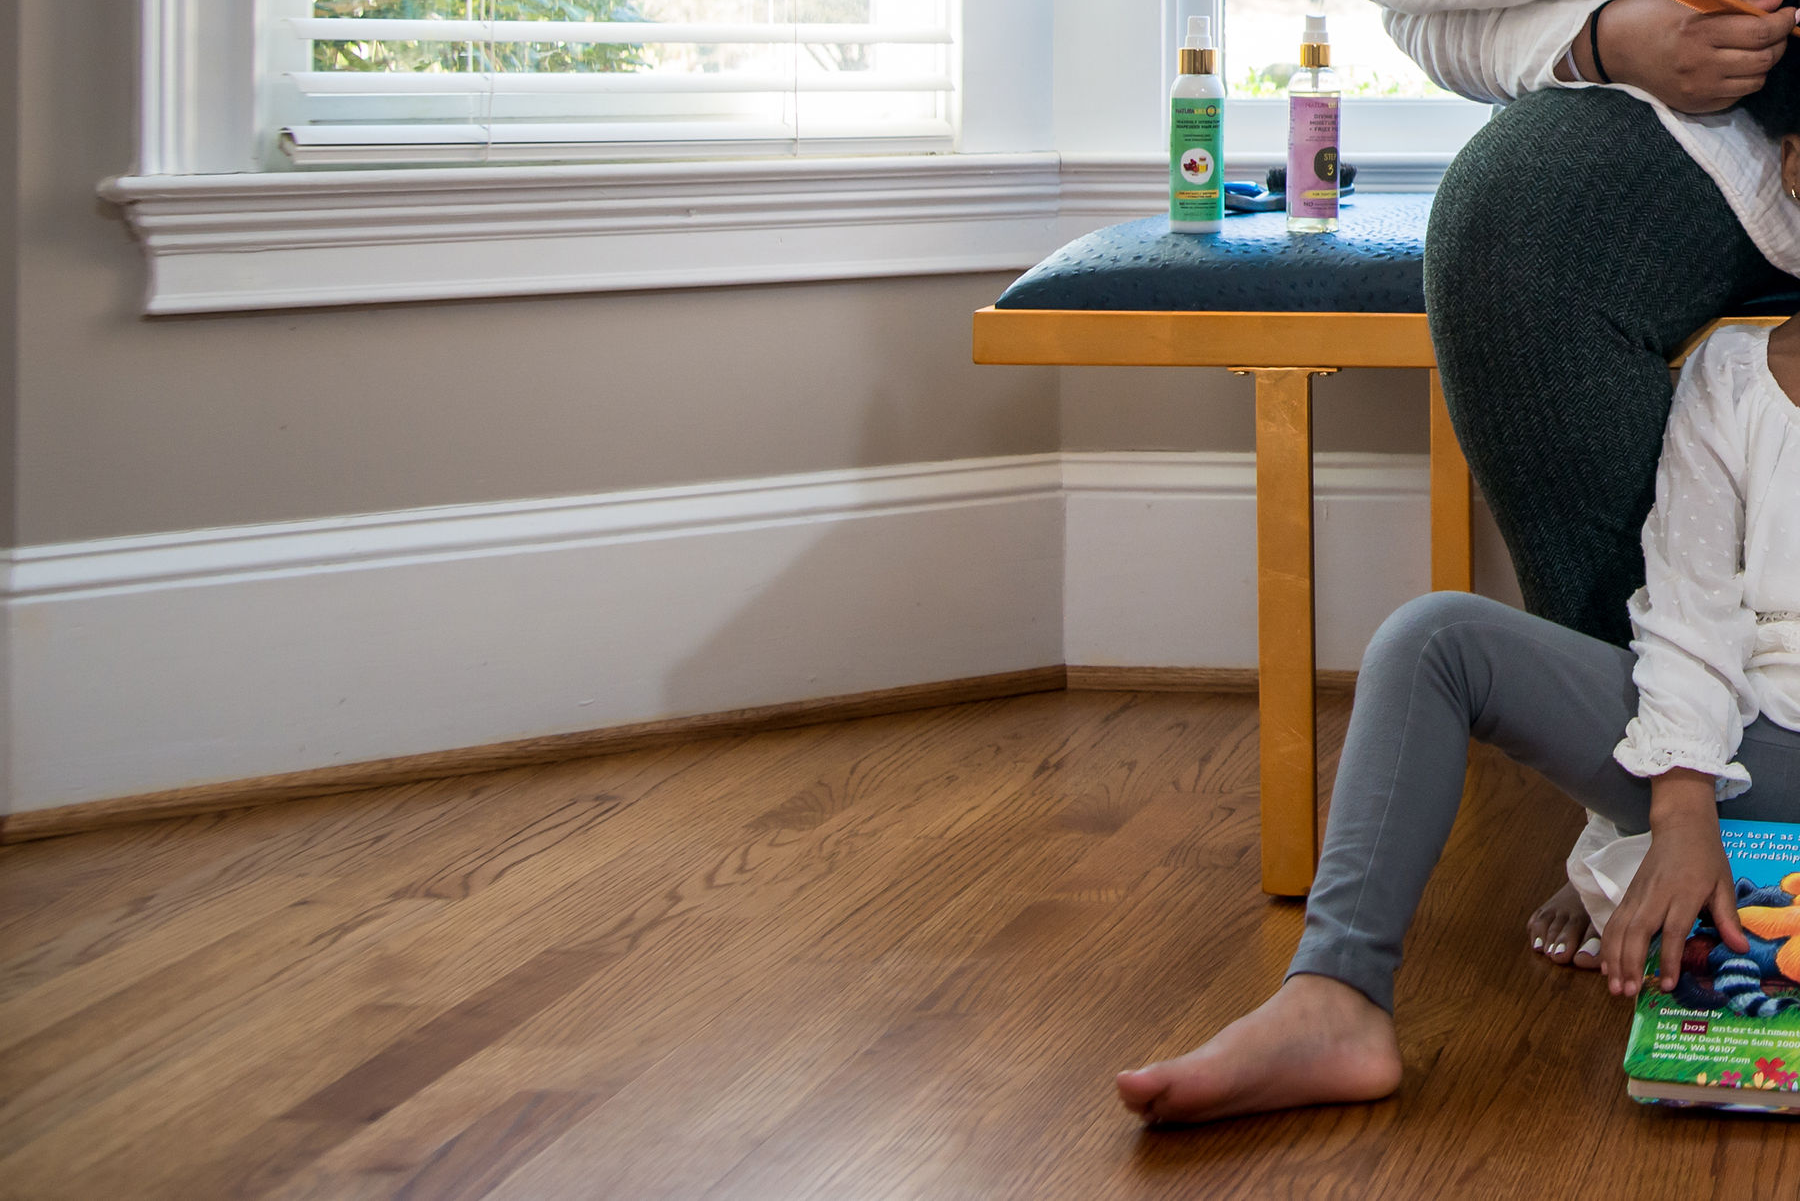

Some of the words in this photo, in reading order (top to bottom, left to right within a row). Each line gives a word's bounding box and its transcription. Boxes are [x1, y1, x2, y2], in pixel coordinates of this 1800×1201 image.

[1327, 163, 1334, 176] 3
[1720, 829, 1743, 838] low
[1747, 831, 1776, 840] Bear
[1780, 833, 1794, 841] as
[1751, 841, 1766, 849] of
[1737, 850, 1800, 864] friendship
[1659, 1008, 1709, 1018] Distributed
[1711, 1009, 1723, 1019] by
[1656, 1021, 1678, 1032] big
[1683, 1022, 1706, 1032] box
[1653, 1041, 1688, 1052] Seattle,
[1690, 1044, 1706, 1052] WA
[1656, 1032, 1678, 1041] 1959
[1679, 1034, 1697, 1043] NW
[1698, 1035, 1721, 1044] Dock
[1724, 1036, 1749, 1046] Place
[1751, 1038, 1775, 1047] Suite
[1776, 1040, 1800, 1049] 2000
[1652, 1052, 1751, 1065] www.bigbox-ent.com
